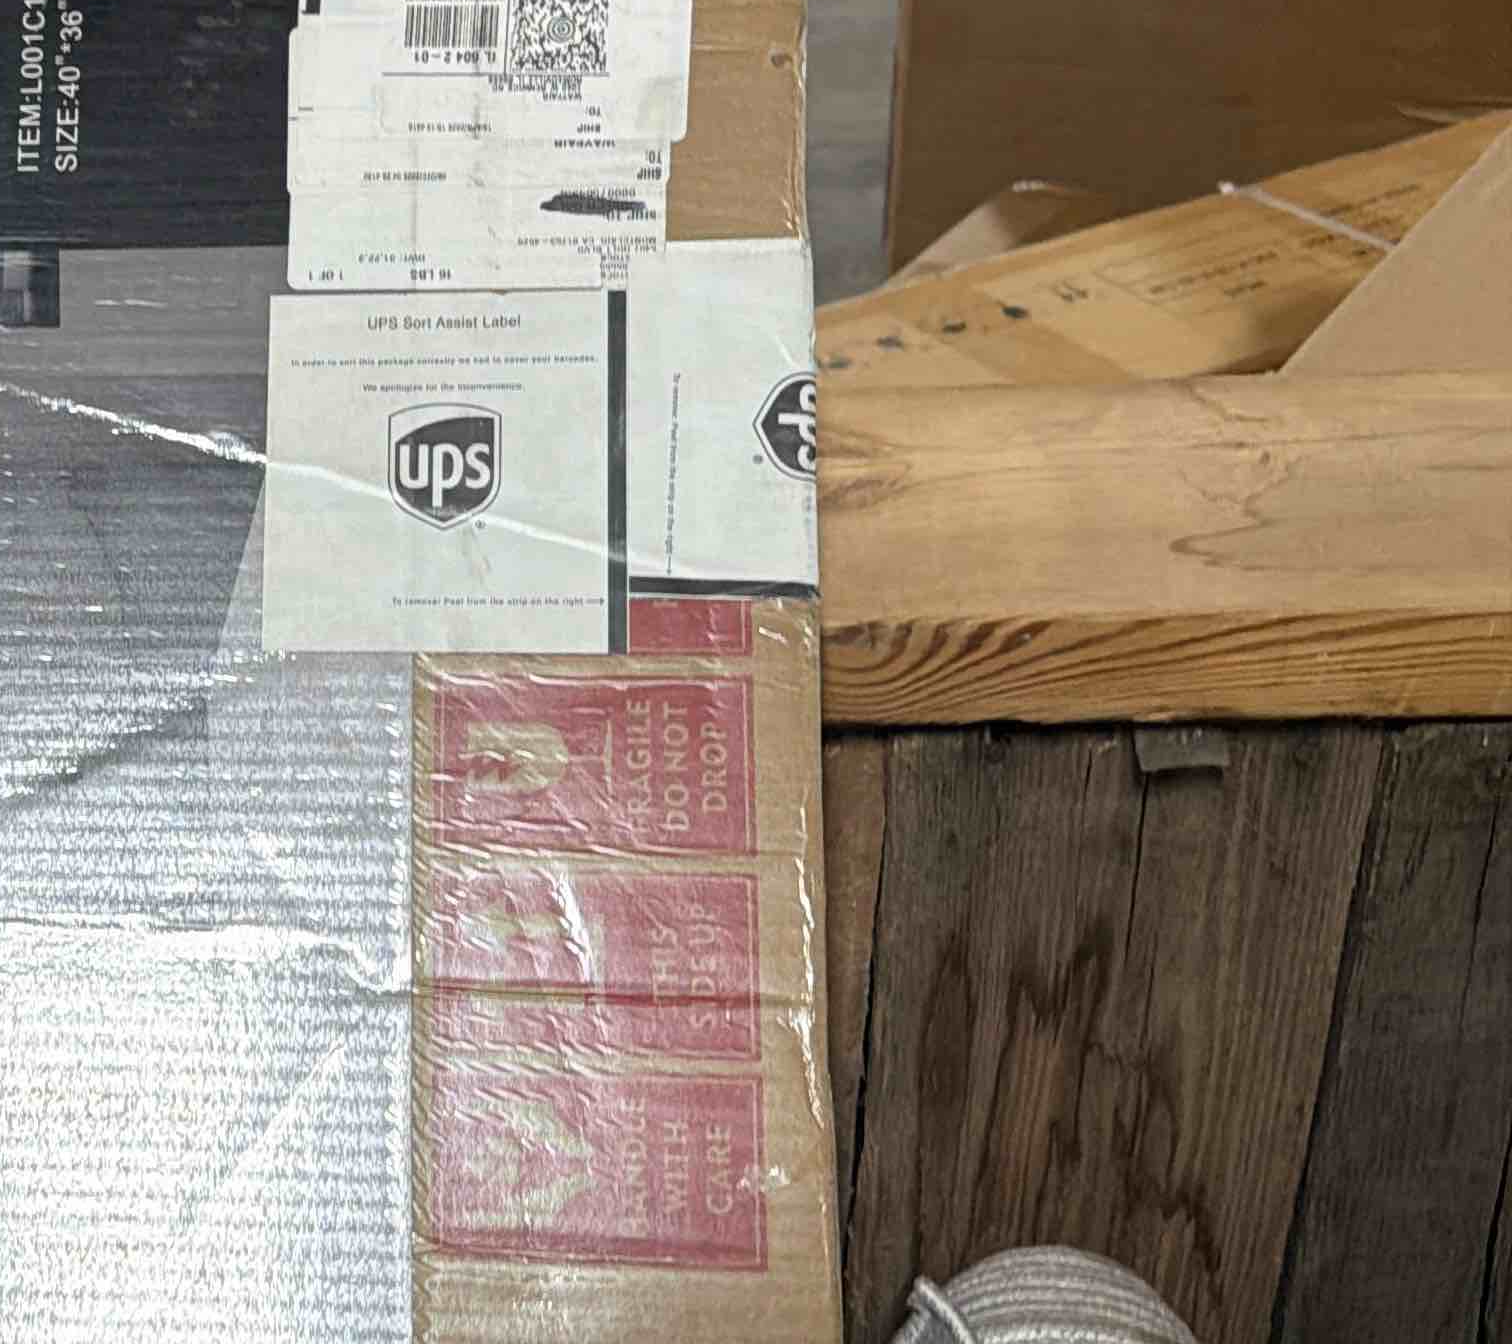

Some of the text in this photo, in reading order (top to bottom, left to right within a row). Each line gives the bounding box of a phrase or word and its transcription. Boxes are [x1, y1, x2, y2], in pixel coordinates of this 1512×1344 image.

[367, 313, 522, 331] UPS Sort Assist Label
[399, 442, 492, 508] ups
[663, 701, 689, 832] DO NOT
[699, 721, 729, 814] DROP
[705, 1122, 733, 1215] CARE
